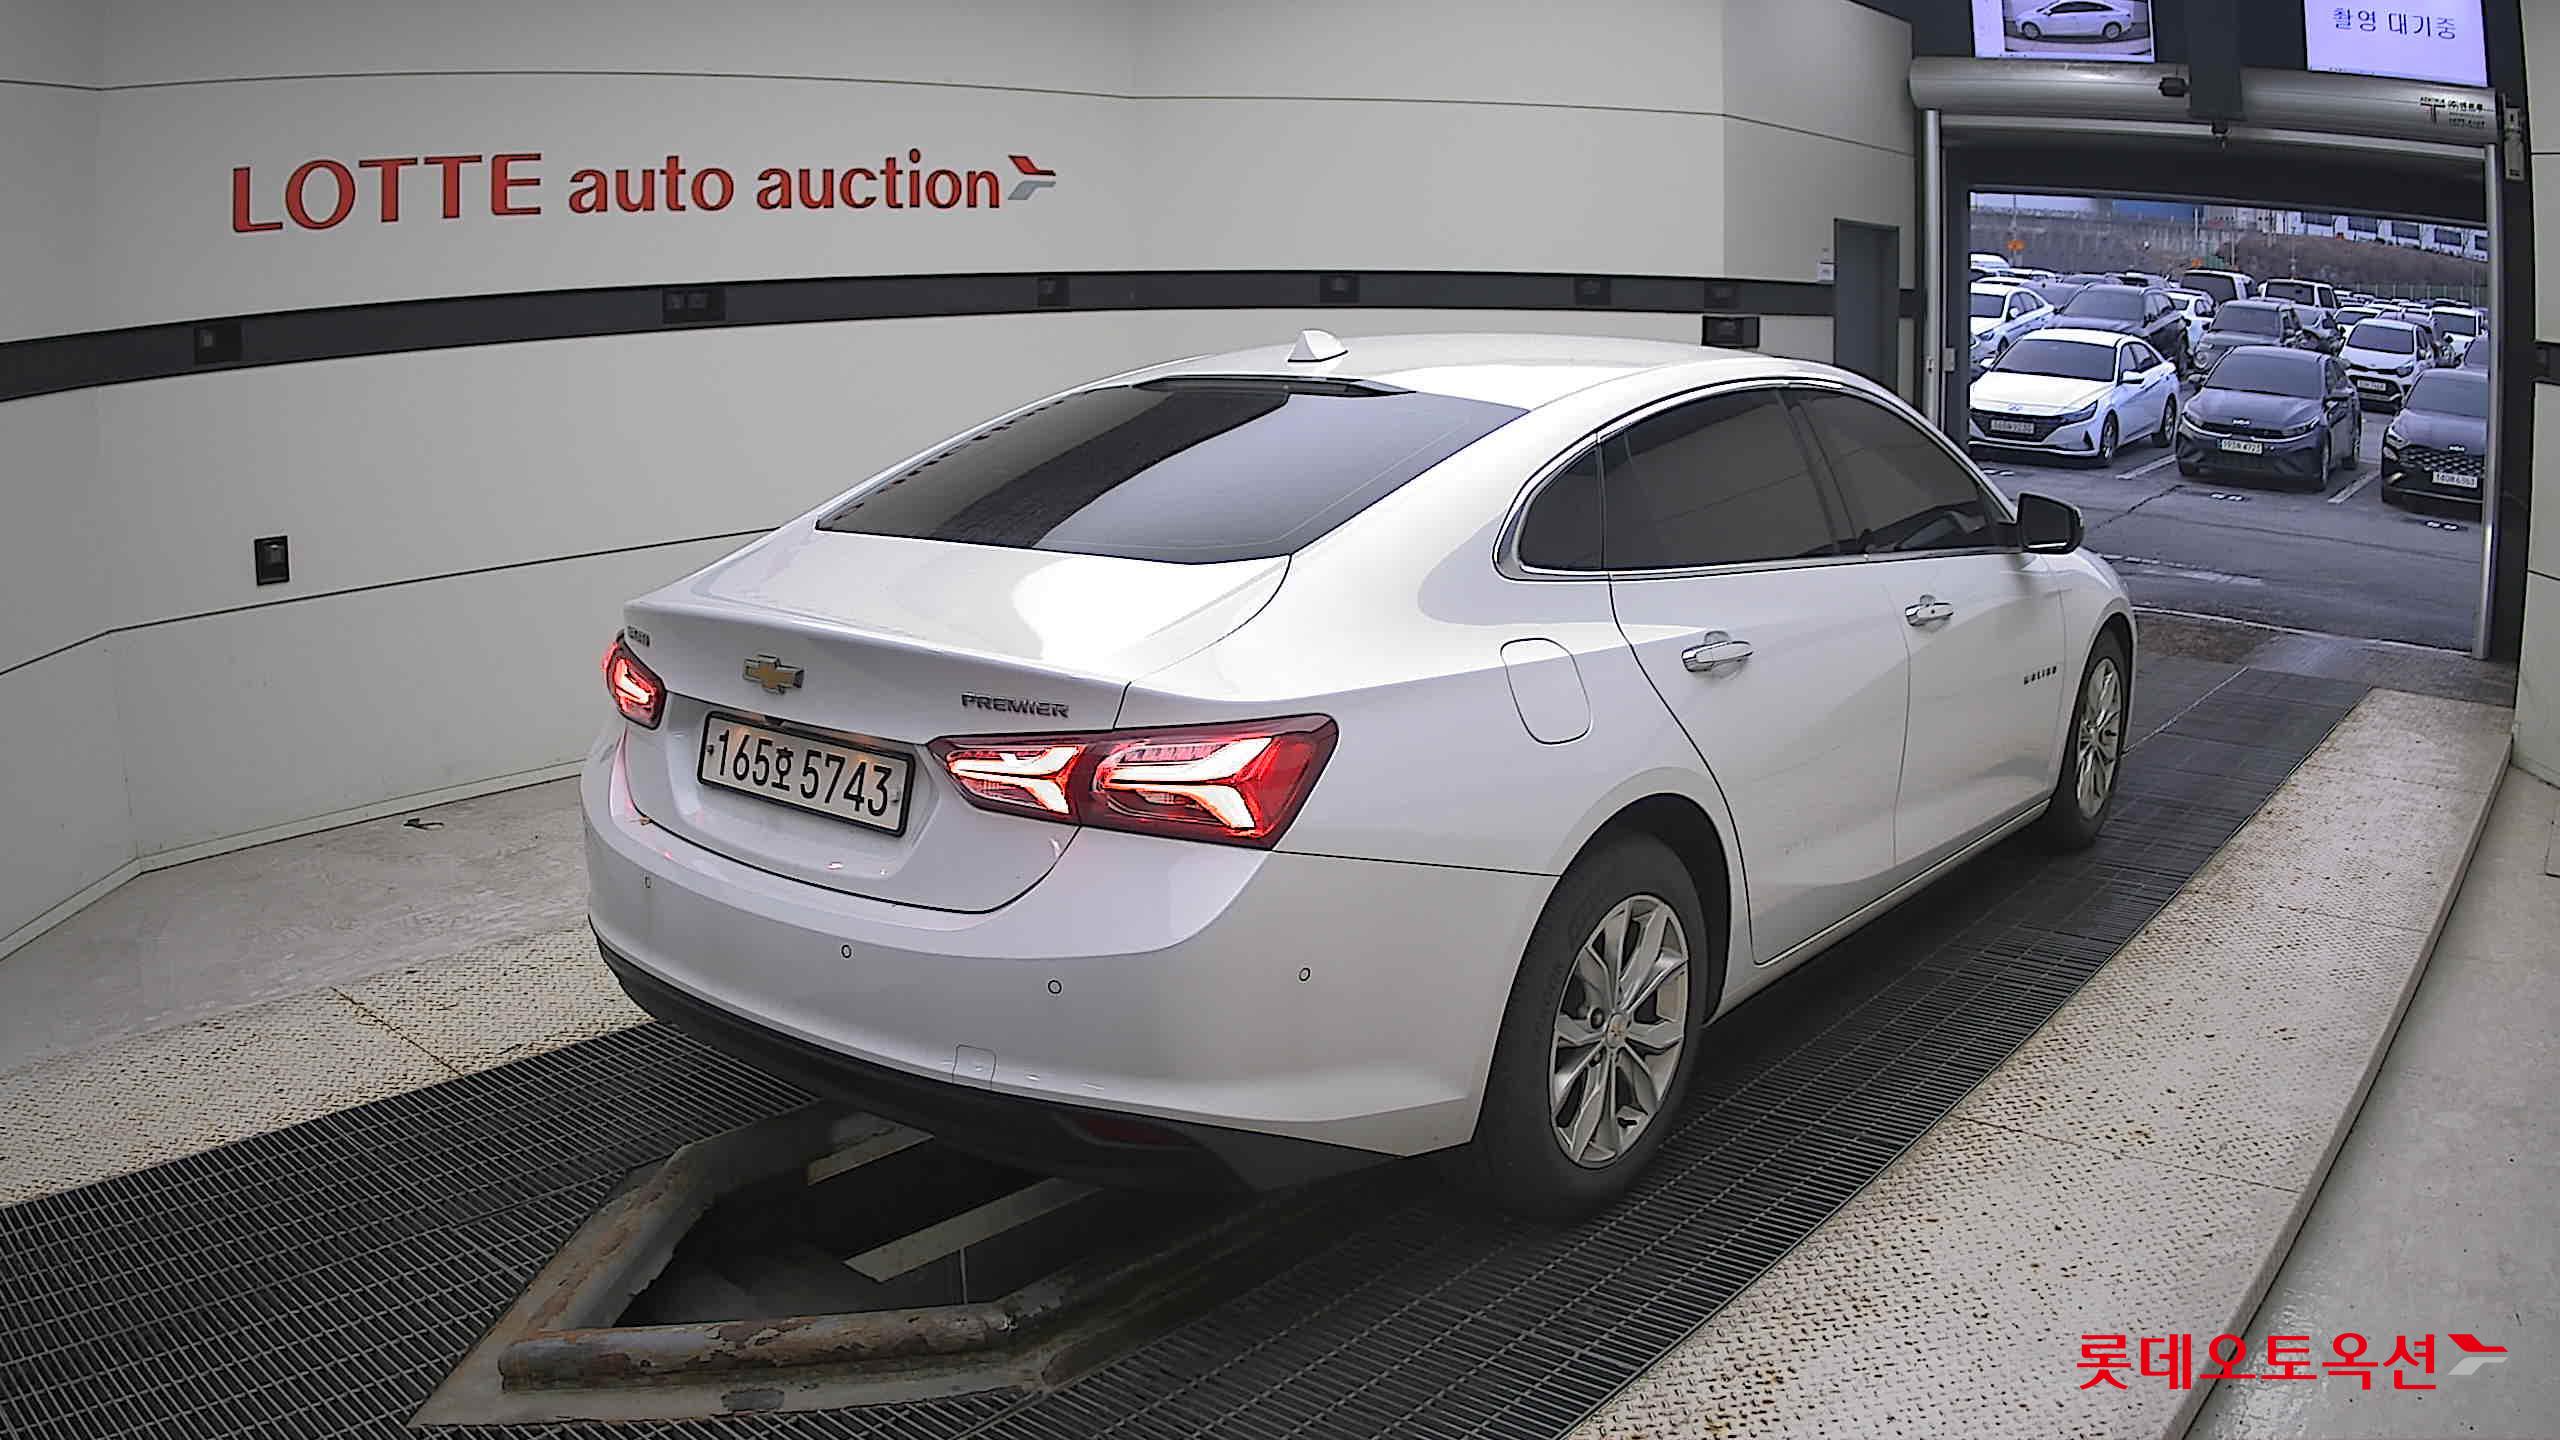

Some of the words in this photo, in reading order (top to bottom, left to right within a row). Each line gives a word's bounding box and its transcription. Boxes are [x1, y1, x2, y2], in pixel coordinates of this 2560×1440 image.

[2388, 12, 2456, 40] 대기중
[232, 152, 542, 233] LOTTE
[568, 155, 735, 214] auto
[756, 148, 1001, 209] auction
[961, 693, 1069, 718] PREMIER
[719, 729, 794, 792] 165호
[800, 749, 893, 817] 5743
